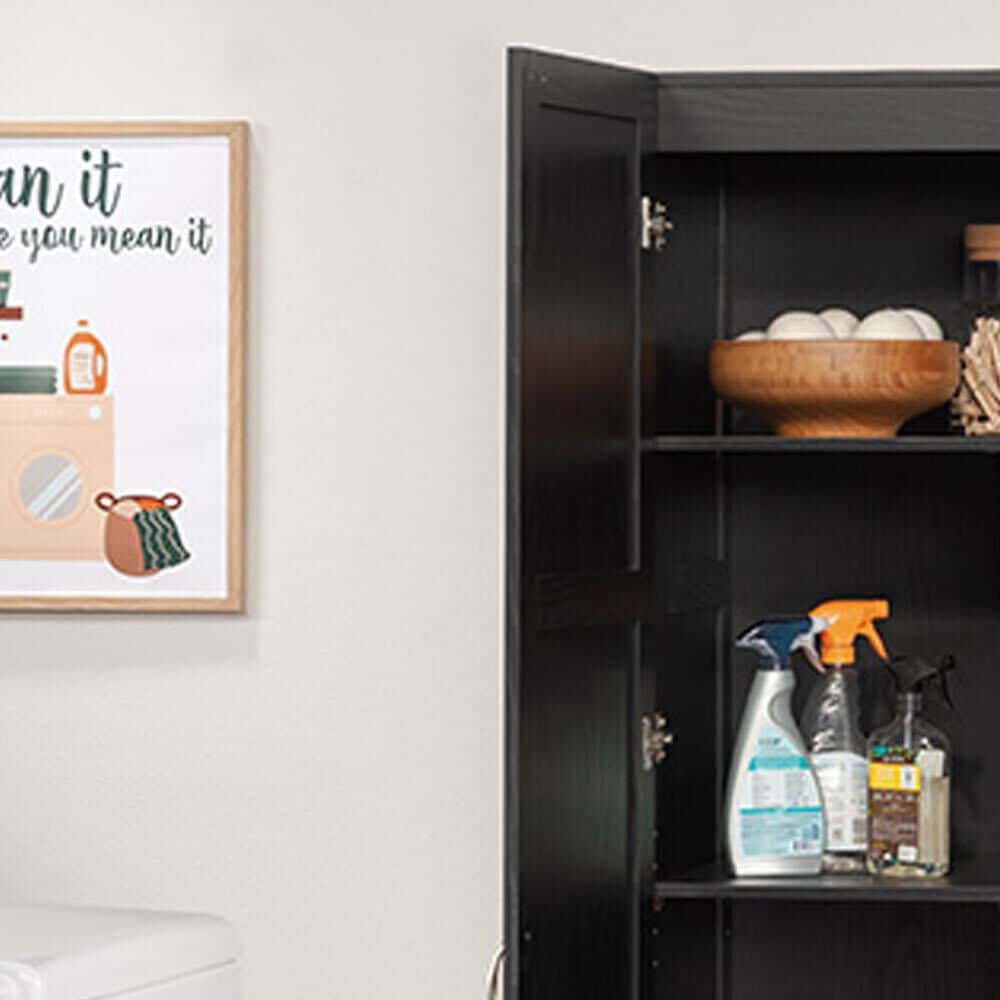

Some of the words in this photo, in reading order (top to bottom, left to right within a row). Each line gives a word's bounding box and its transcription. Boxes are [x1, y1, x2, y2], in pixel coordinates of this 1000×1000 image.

[81, 149, 123, 218] it
[20, 225, 82, 264] you
[90, 224, 181, 255] mean
[188, 217, 213, 255] it
